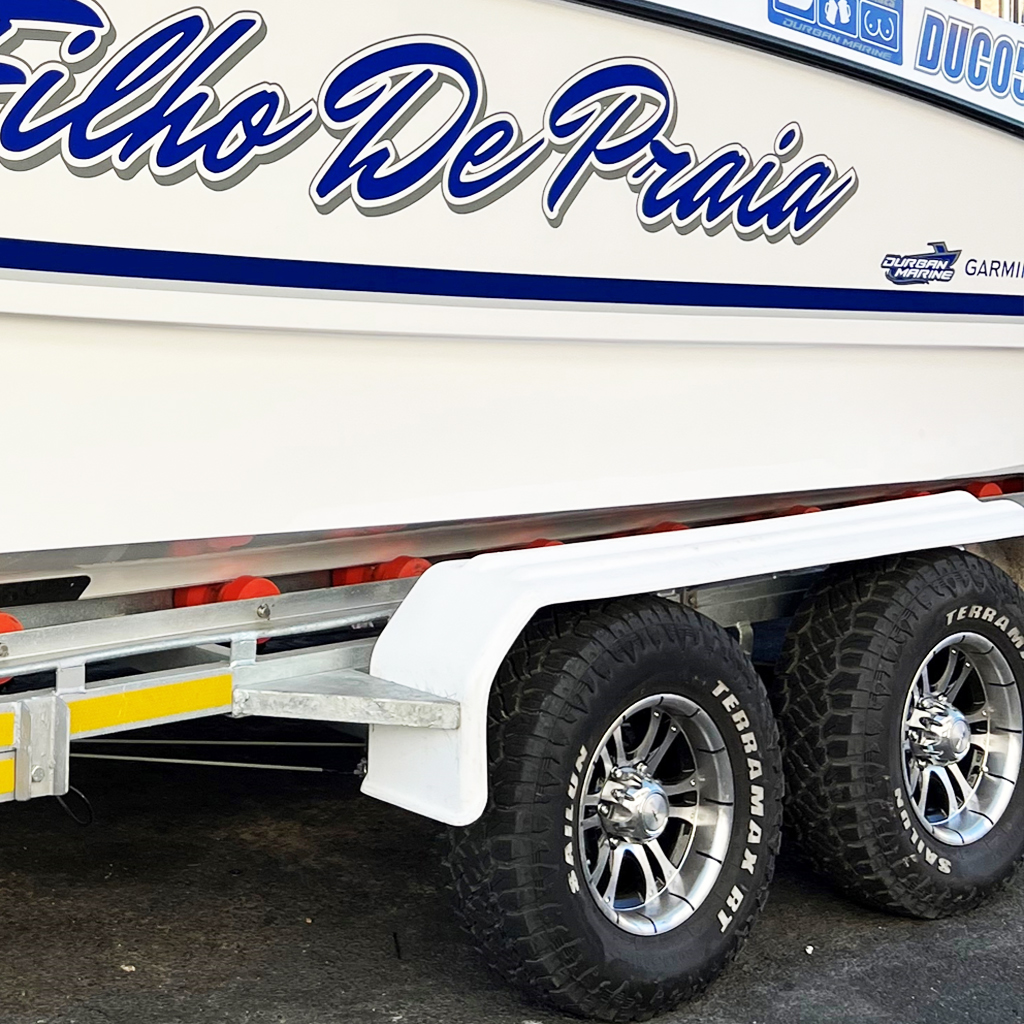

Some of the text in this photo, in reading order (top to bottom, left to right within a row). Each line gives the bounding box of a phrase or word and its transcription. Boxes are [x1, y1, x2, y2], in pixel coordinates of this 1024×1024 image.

[782, 17, 893, 61] DURBAN MARINE
[309, 33, 553, 217] De
[542, 56, 860, 245] Praia
[881, 255, 950, 270] DURBAN
[893, 267, 954, 281] MARINE
[964, 258, 1024, 279] GARMI
[945, 604, 1024, 660] TERRAM
[564, 744, 588, 894] SAILUN
[711, 679, 764, 933] TERRAMAX RT
[894, 787, 952, 874] SAILUN
